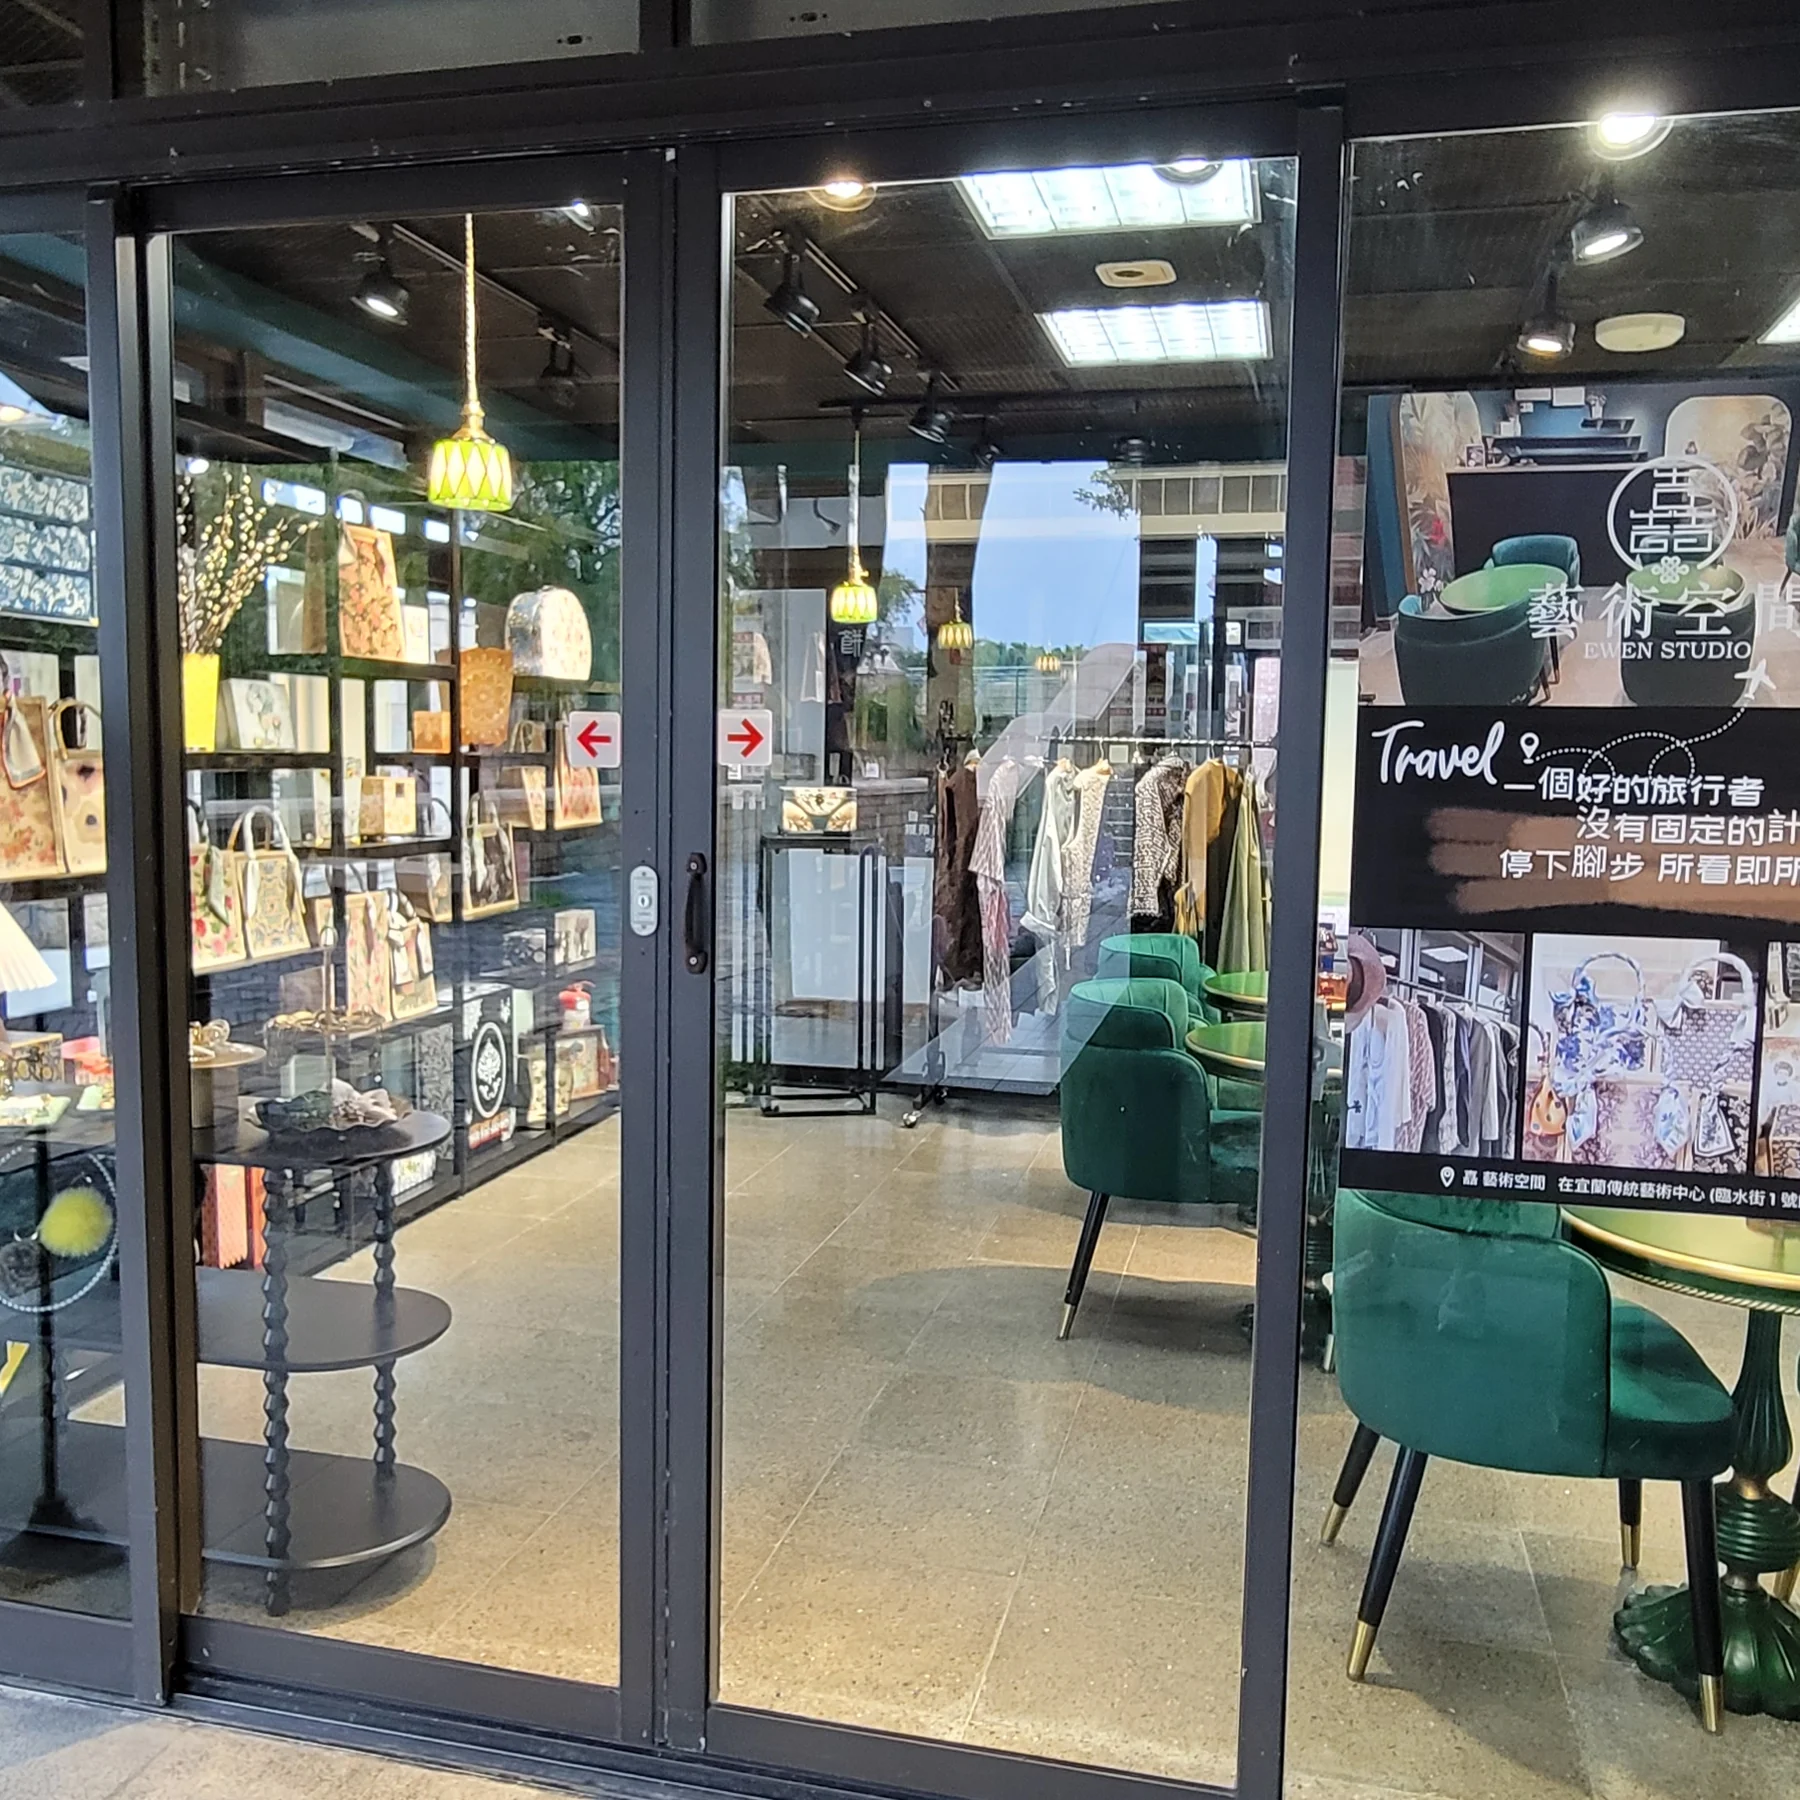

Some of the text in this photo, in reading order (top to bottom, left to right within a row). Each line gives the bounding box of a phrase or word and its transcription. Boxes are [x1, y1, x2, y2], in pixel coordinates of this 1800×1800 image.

[1526, 583, 1800, 640] 藝術空間
[1584, 641, 1752, 660] EWEN STUDIO
[1372, 720, 1505, 786] Travel
[1504, 766, 1766, 808] 一個好的旅行者
[1576, 805, 1800, 847] 沒有固定的計
[1500, 844, 1645, 882] 停下腳步
[1482, 1170, 1546, 1191] 藝術空間
[1558, 1176, 1706, 1202] 在宜蘭傳統藝術中心
[1781, 1191, 1800, 1210] 號
